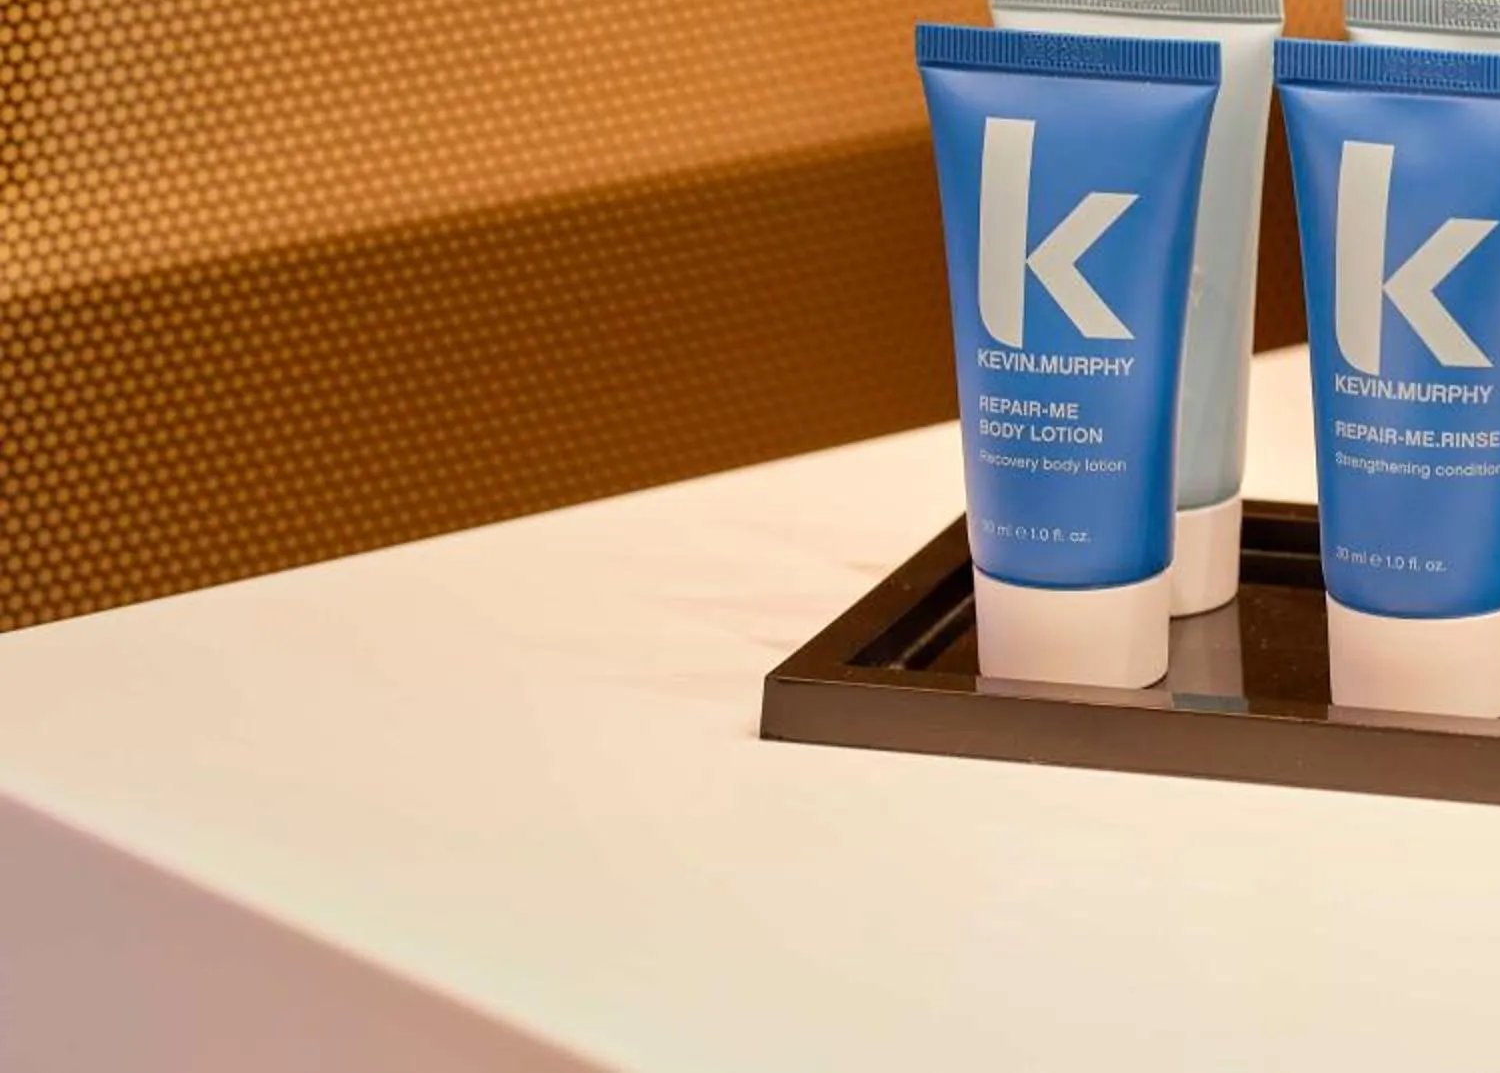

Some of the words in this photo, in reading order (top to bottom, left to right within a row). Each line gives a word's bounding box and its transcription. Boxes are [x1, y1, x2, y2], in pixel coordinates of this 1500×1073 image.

[977, 348, 1135, 377] KEVIN.MURPHY
[1334, 373, 1495, 405] KEVIN.MURPHY
[979, 395, 1079, 420] REPAIR-ME
[979, 419, 1025, 440] BODY
[1031, 425, 1103, 444] LOTION
[979, 449, 1039, 473] Recovery
[1042, 456, 1081, 474] body
[1085, 458, 1127, 473] lotion
[1334, 451, 1431, 480] Strengthening
[1351, 550, 1367, 565] ml
[1385, 556, 1405, 570] 1.0
[1408, 556, 1421, 572] fl.
[1425, 561, 1448, 573] oz.
